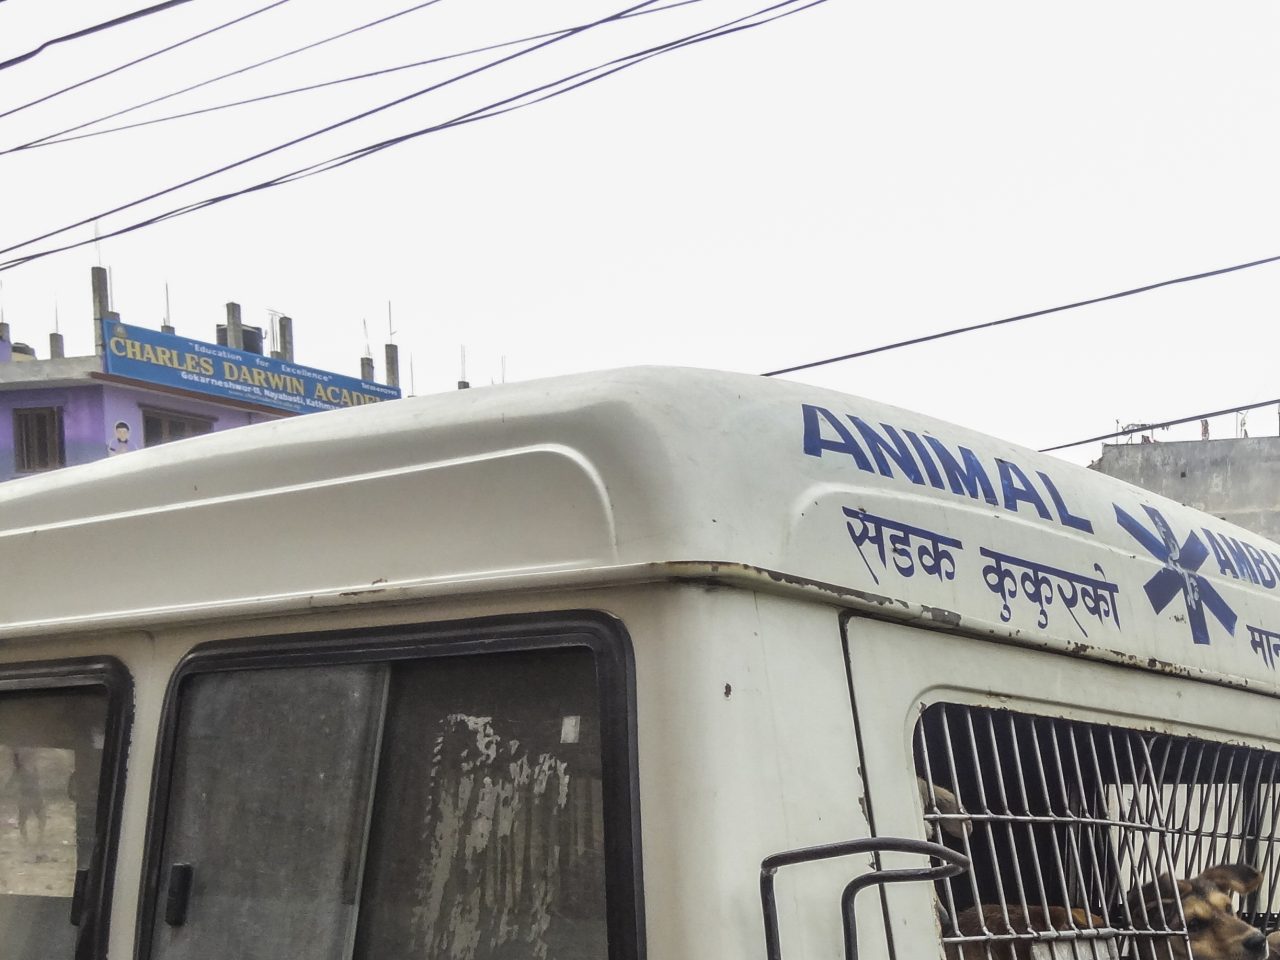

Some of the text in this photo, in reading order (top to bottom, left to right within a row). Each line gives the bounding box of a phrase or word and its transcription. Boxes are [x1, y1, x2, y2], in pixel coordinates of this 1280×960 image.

[110, 337, 214, 375] CHARLES
[223, 361, 305, 395] DARWIN
[314, 383, 382, 406] ACADE
[256, 358, 270, 368] for
[802, 403, 1094, 535] ANIMAL
[842, 506, 1122, 638] सडक कुकुरको
